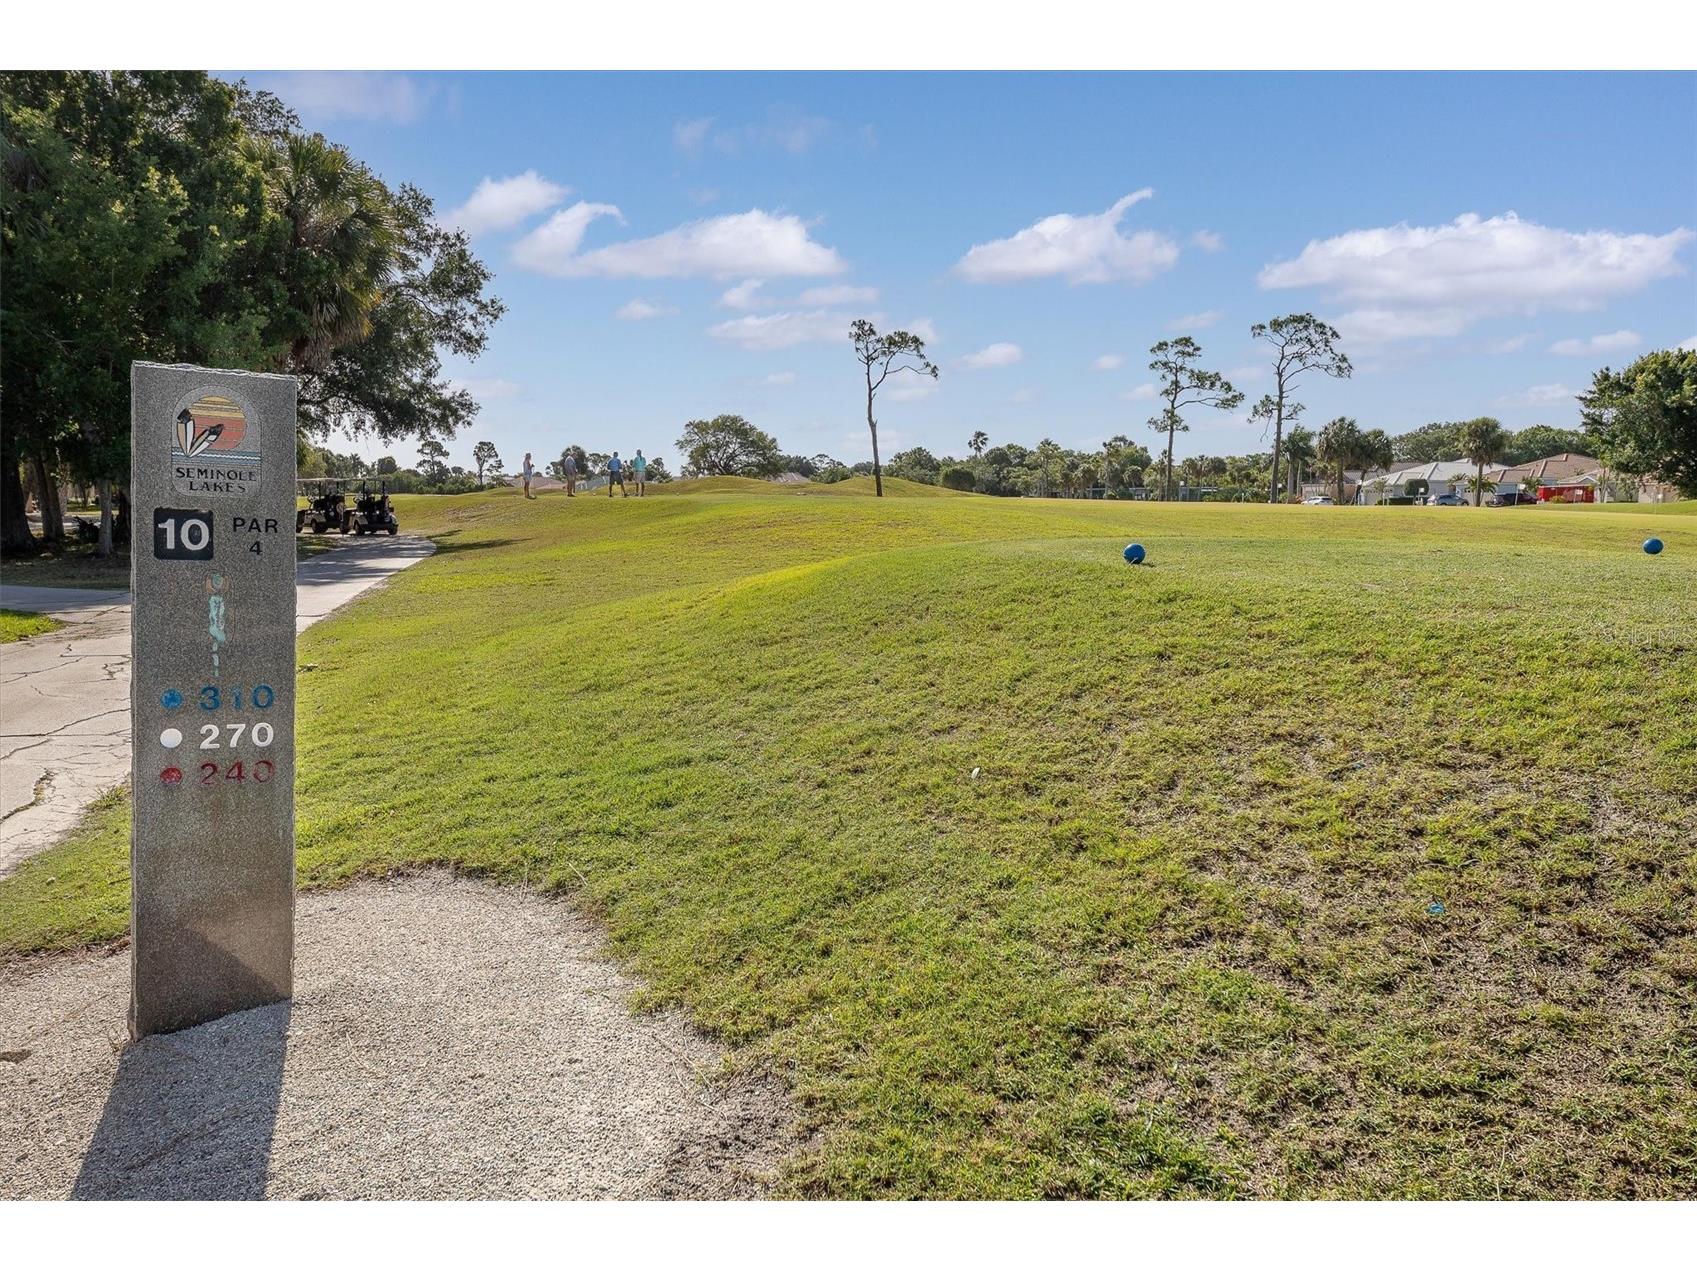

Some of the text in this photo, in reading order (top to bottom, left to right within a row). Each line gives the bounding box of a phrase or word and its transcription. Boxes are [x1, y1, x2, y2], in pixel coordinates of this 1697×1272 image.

[175, 467, 257, 481] SEMINOLE
[188, 481, 246, 493] LAKES
[158, 518, 210, 551] 10
[232, 517, 278, 533] PAR
[249, 540, 263, 556] 4
[200, 684, 275, 711] 310
[199, 722, 274, 749] 270
[200, 758, 276, 785] 240
